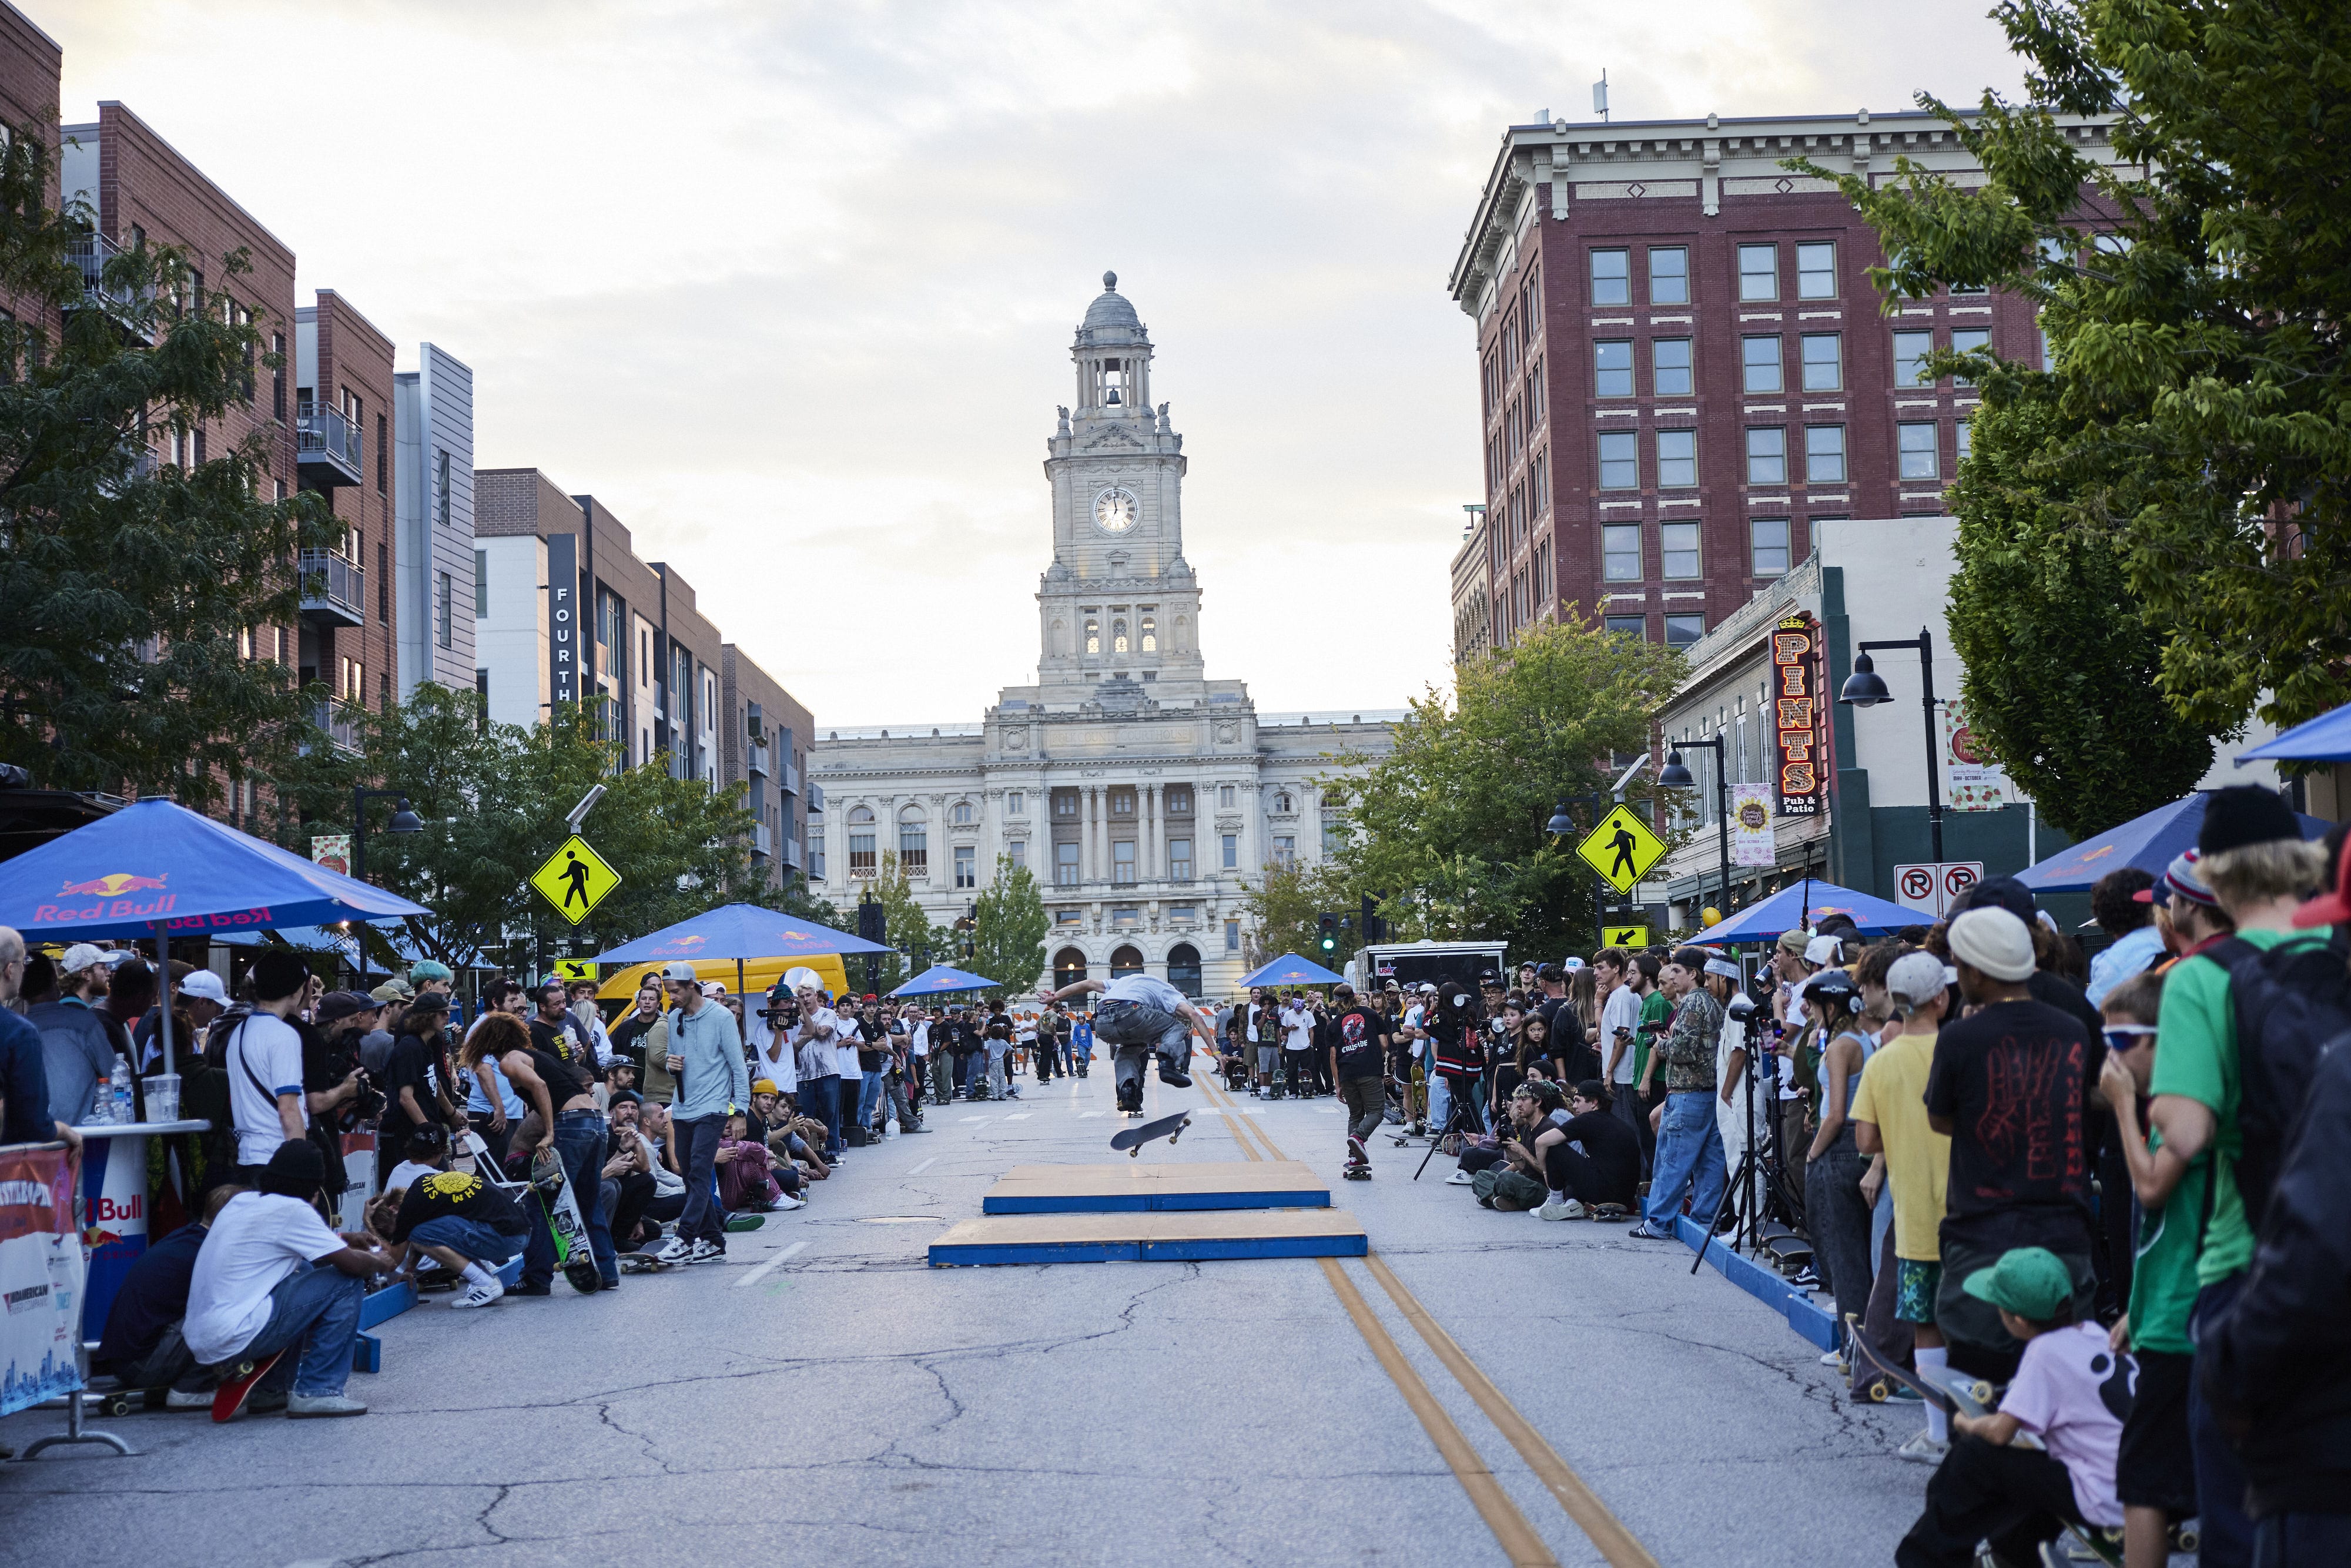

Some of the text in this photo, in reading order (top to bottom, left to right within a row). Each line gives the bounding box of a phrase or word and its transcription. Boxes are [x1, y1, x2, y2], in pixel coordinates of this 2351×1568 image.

[556, 588, 570, 701] FOURTH
[1775, 634, 1815, 793] PINTS
[1783, 797, 1804, 805] Pub
[1786, 805, 1814, 813] Patio
[34, 894, 176, 922] Red Bull
[1341, 1040, 1368, 1053] CRUSADE
[98, 1194, 142, 1221] Bull
[103, 1249, 138, 1261] DRINK
